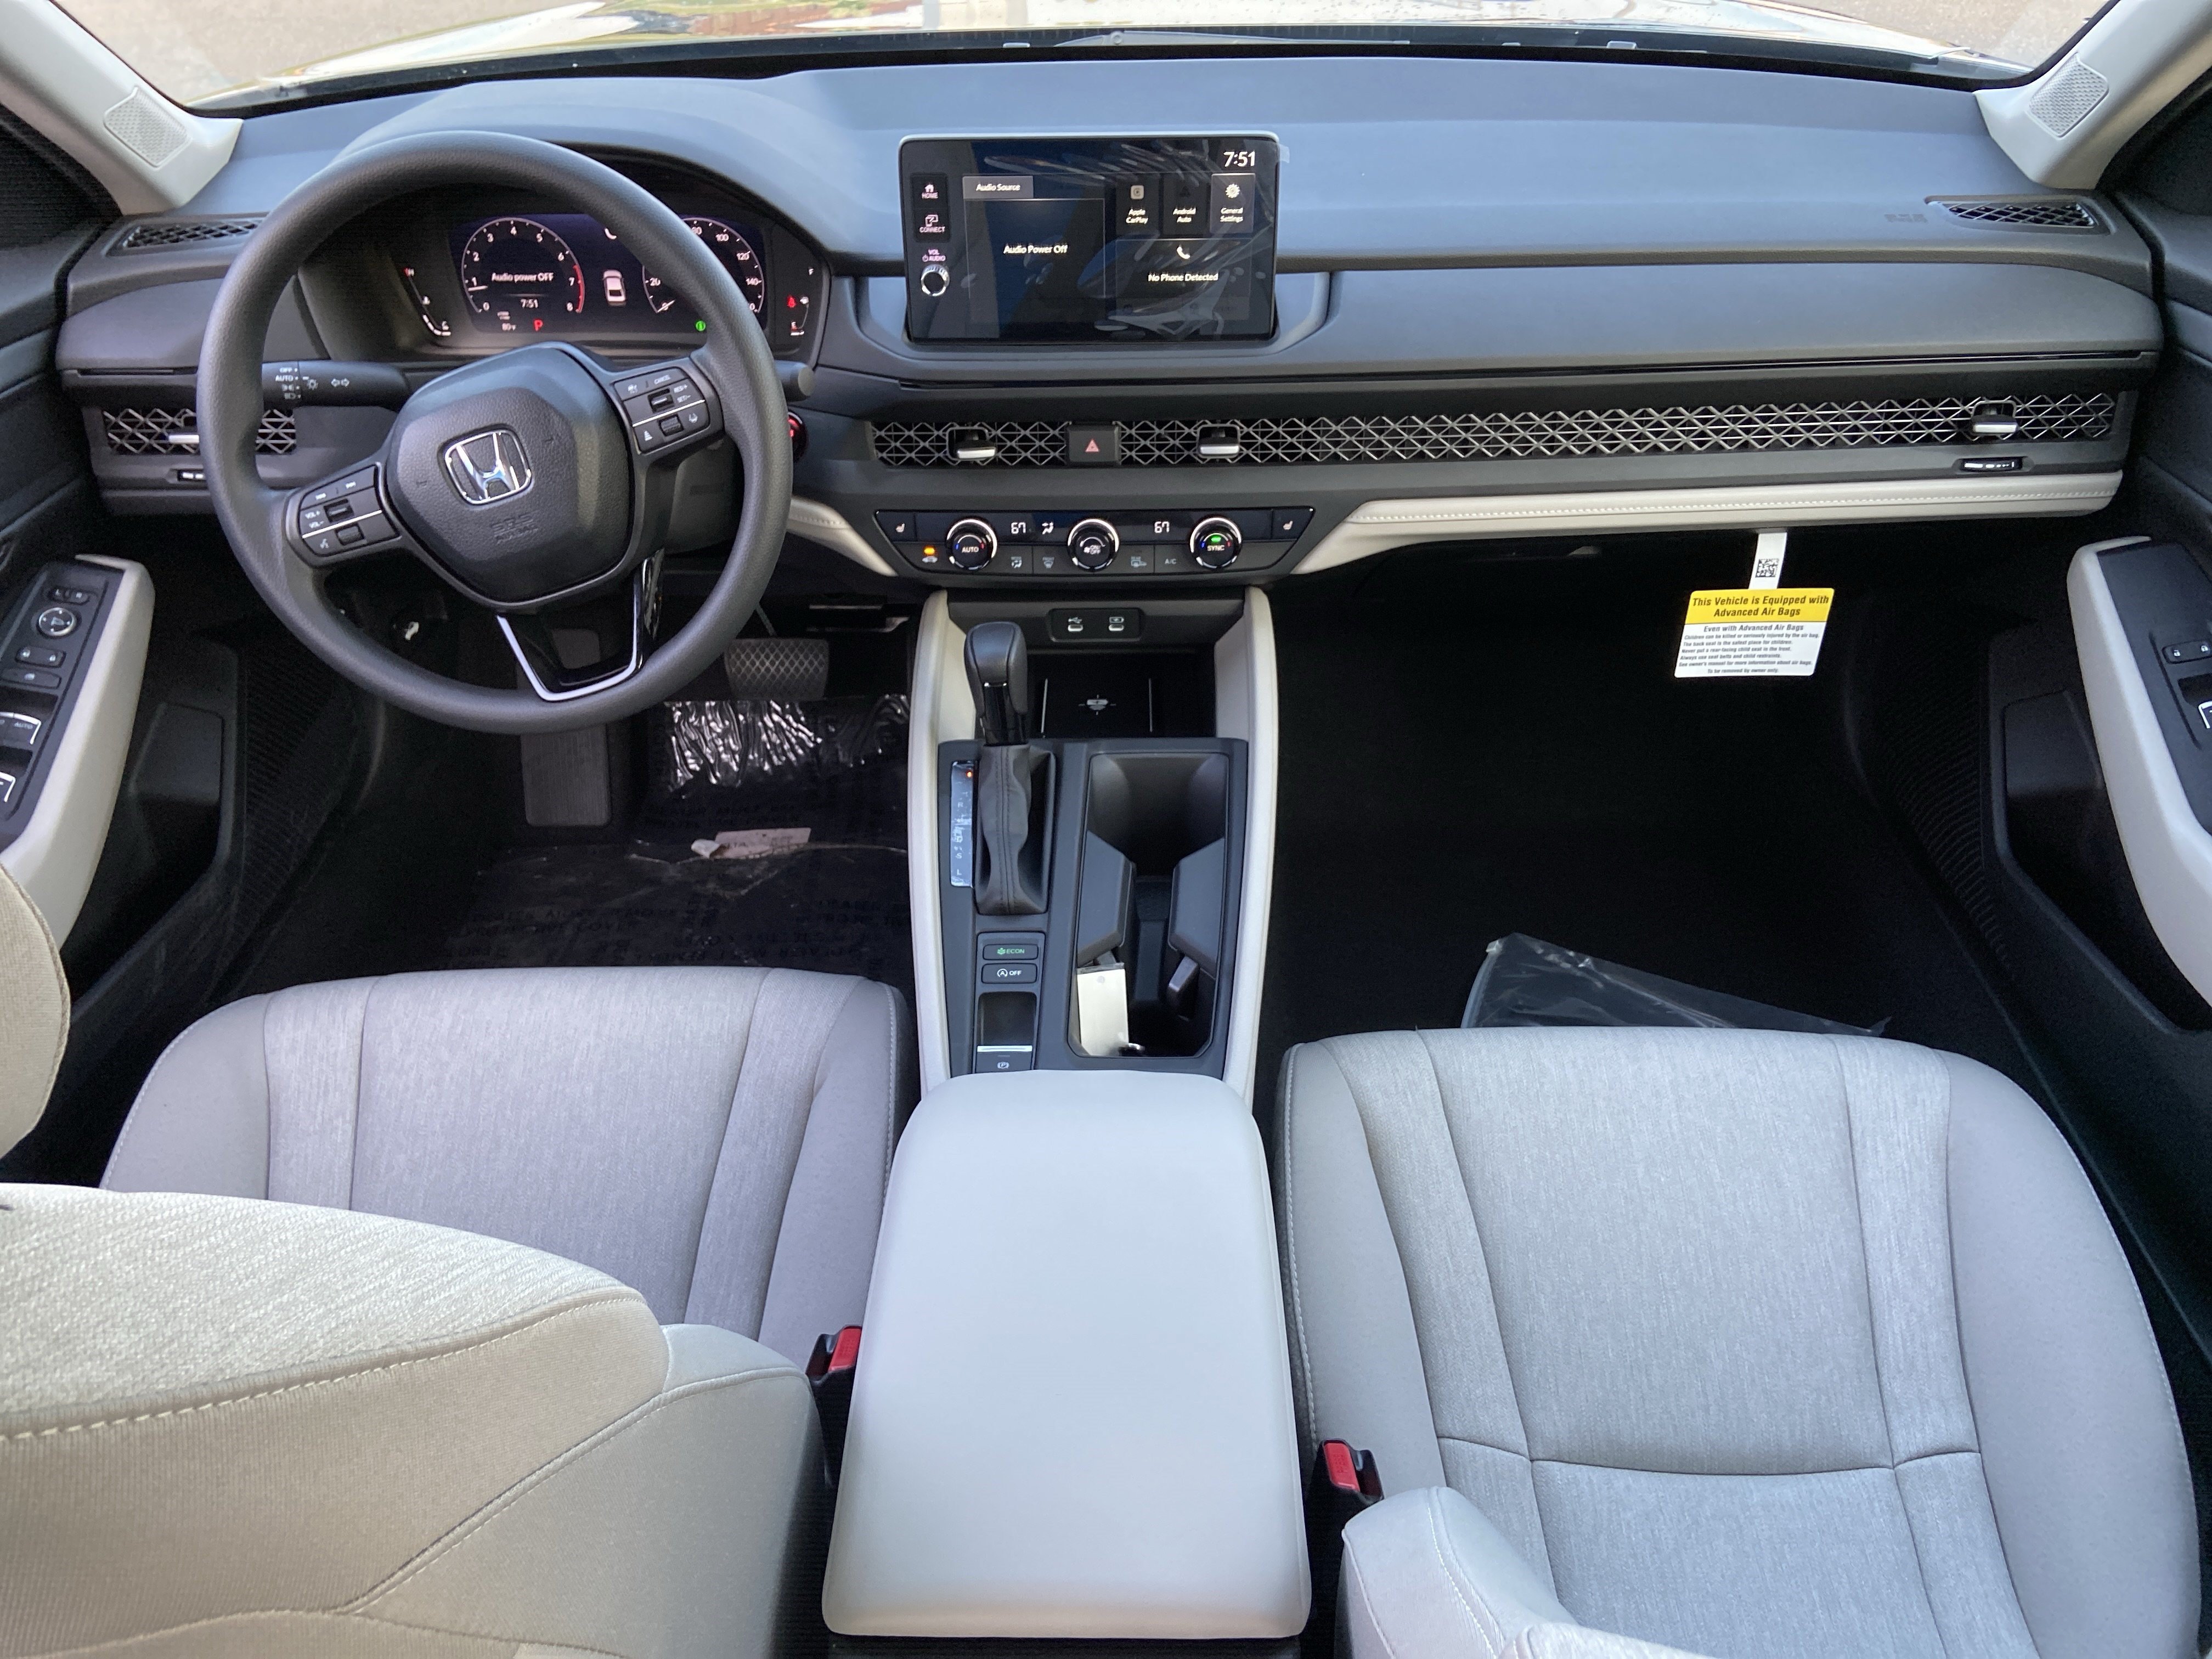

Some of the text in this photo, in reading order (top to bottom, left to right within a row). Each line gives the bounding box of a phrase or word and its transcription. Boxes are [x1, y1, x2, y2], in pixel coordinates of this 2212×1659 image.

[1223, 151, 1255, 167] 7:51
[510, 226, 517, 235] 4
[487, 233, 494, 242] 3
[536, 233, 543, 242] 5
[715, 234, 729, 242] 100
[1003, 244, 1069, 254] Audio Power Off
[473, 251, 480, 262] 2
[557, 252, 565, 261] 6
[737, 252, 749, 261] 120
[471, 276, 477, 286] 1
[492, 272, 554, 283] Audio power OFF
[568, 276, 575, 286] 7
[1148, 272, 1218, 281] No Phone Detected
[483, 302, 490, 311] 0
[566, 302, 573, 312] 8
[534, 319, 543, 331] P
[1011, 522, 1026, 534] 67
[1154, 521, 1170, 533] 67
[1692, 595, 1829, 606] This Vehicle is Equipped with
[1713, 607, 1801, 617] Advanced Air Bags
